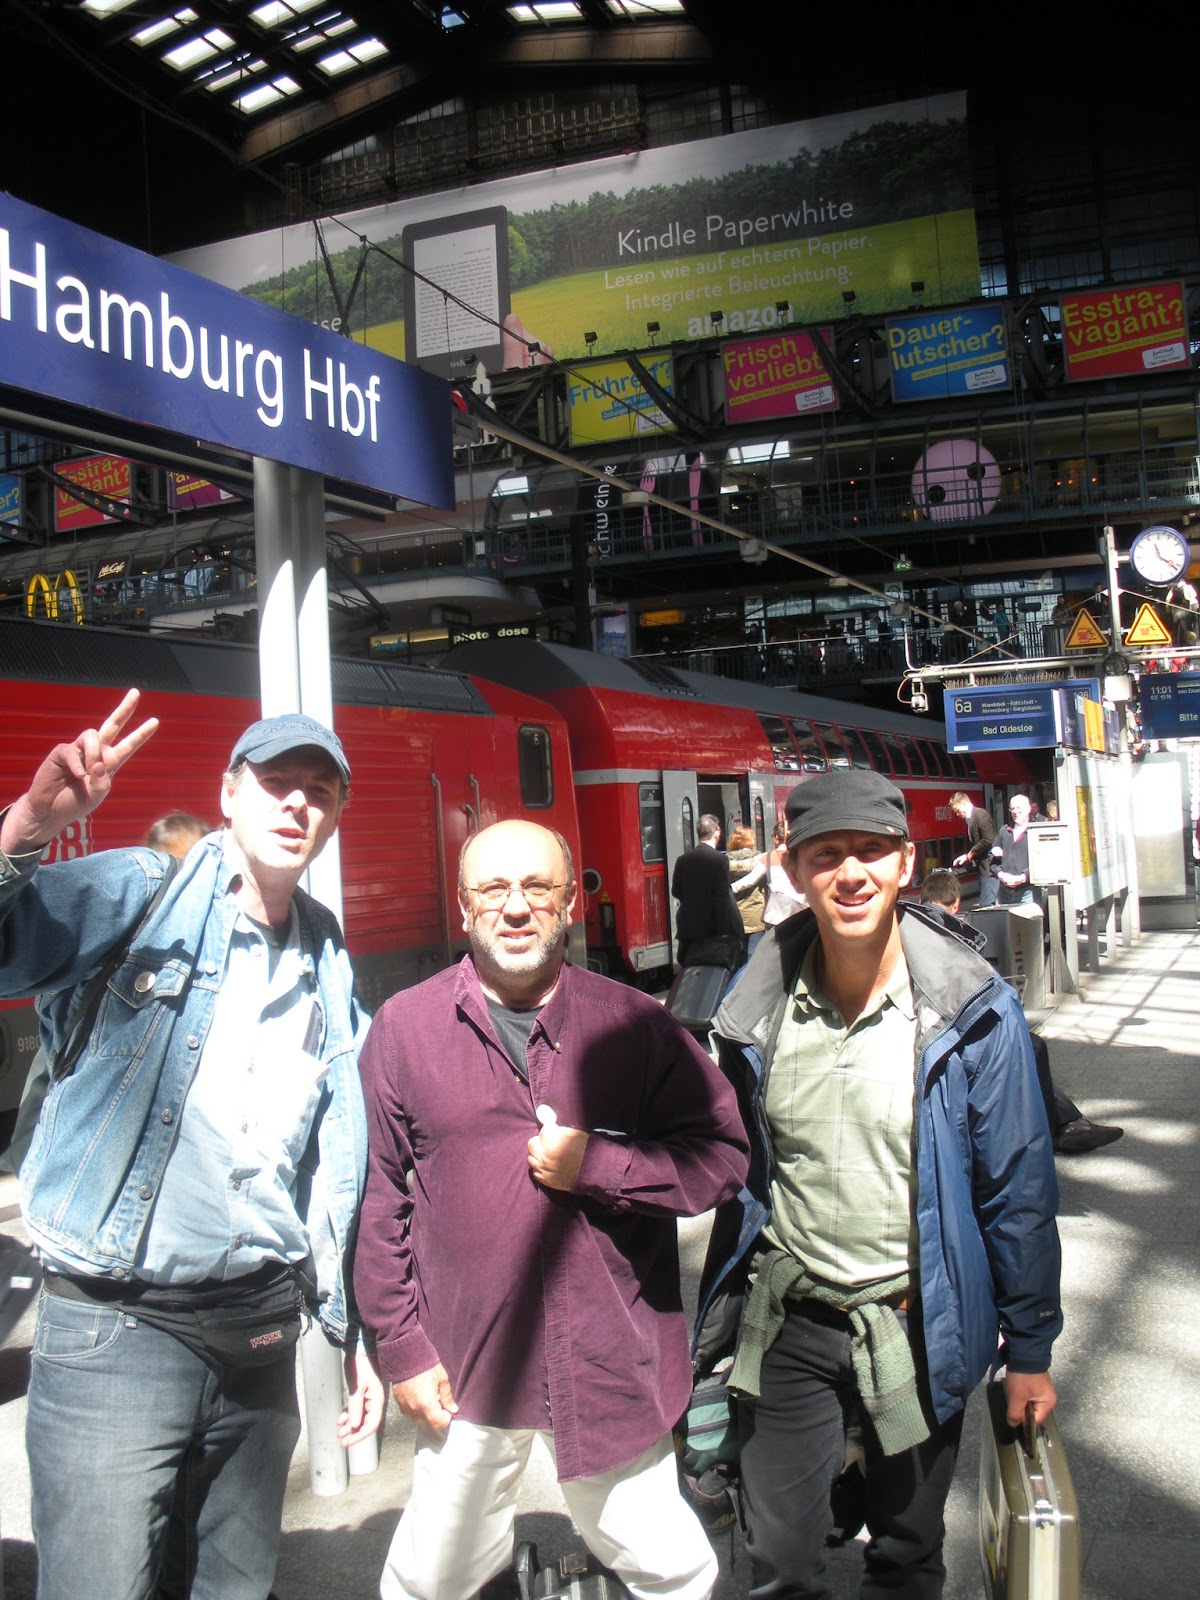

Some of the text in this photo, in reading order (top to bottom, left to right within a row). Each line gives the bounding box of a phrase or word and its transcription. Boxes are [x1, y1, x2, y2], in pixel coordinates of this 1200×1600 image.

[618, 198, 854, 255] Kindle Paperwhite
[605, 235, 872, 289] Lesen wie auf echtem Papier.
[625, 264, 853, 312] Integrierte Beleuchtung.
[1062, 291, 1163, 327] Esstra-
[1068, 299, 1183, 347] vagant?
[0, 229, 283, 427] Hamburg
[304, 349, 380, 442] Hbf
[888, 316, 971, 349] Dauer-
[892, 324, 1005, 371] lutscher?
[724, 337, 797, 373] Frisch
[729, 352, 823, 392] verliebt
[569, 361, 671, 406] Frühref?
[497, 626, 529, 638] dose
[955, 699, 972, 713] 6a
[1150, 685, 1171, 695] 11:01
[983, 723, 1033, 735] Bad Oldesloe
[1179, 712, 1198, 721] Bitte
